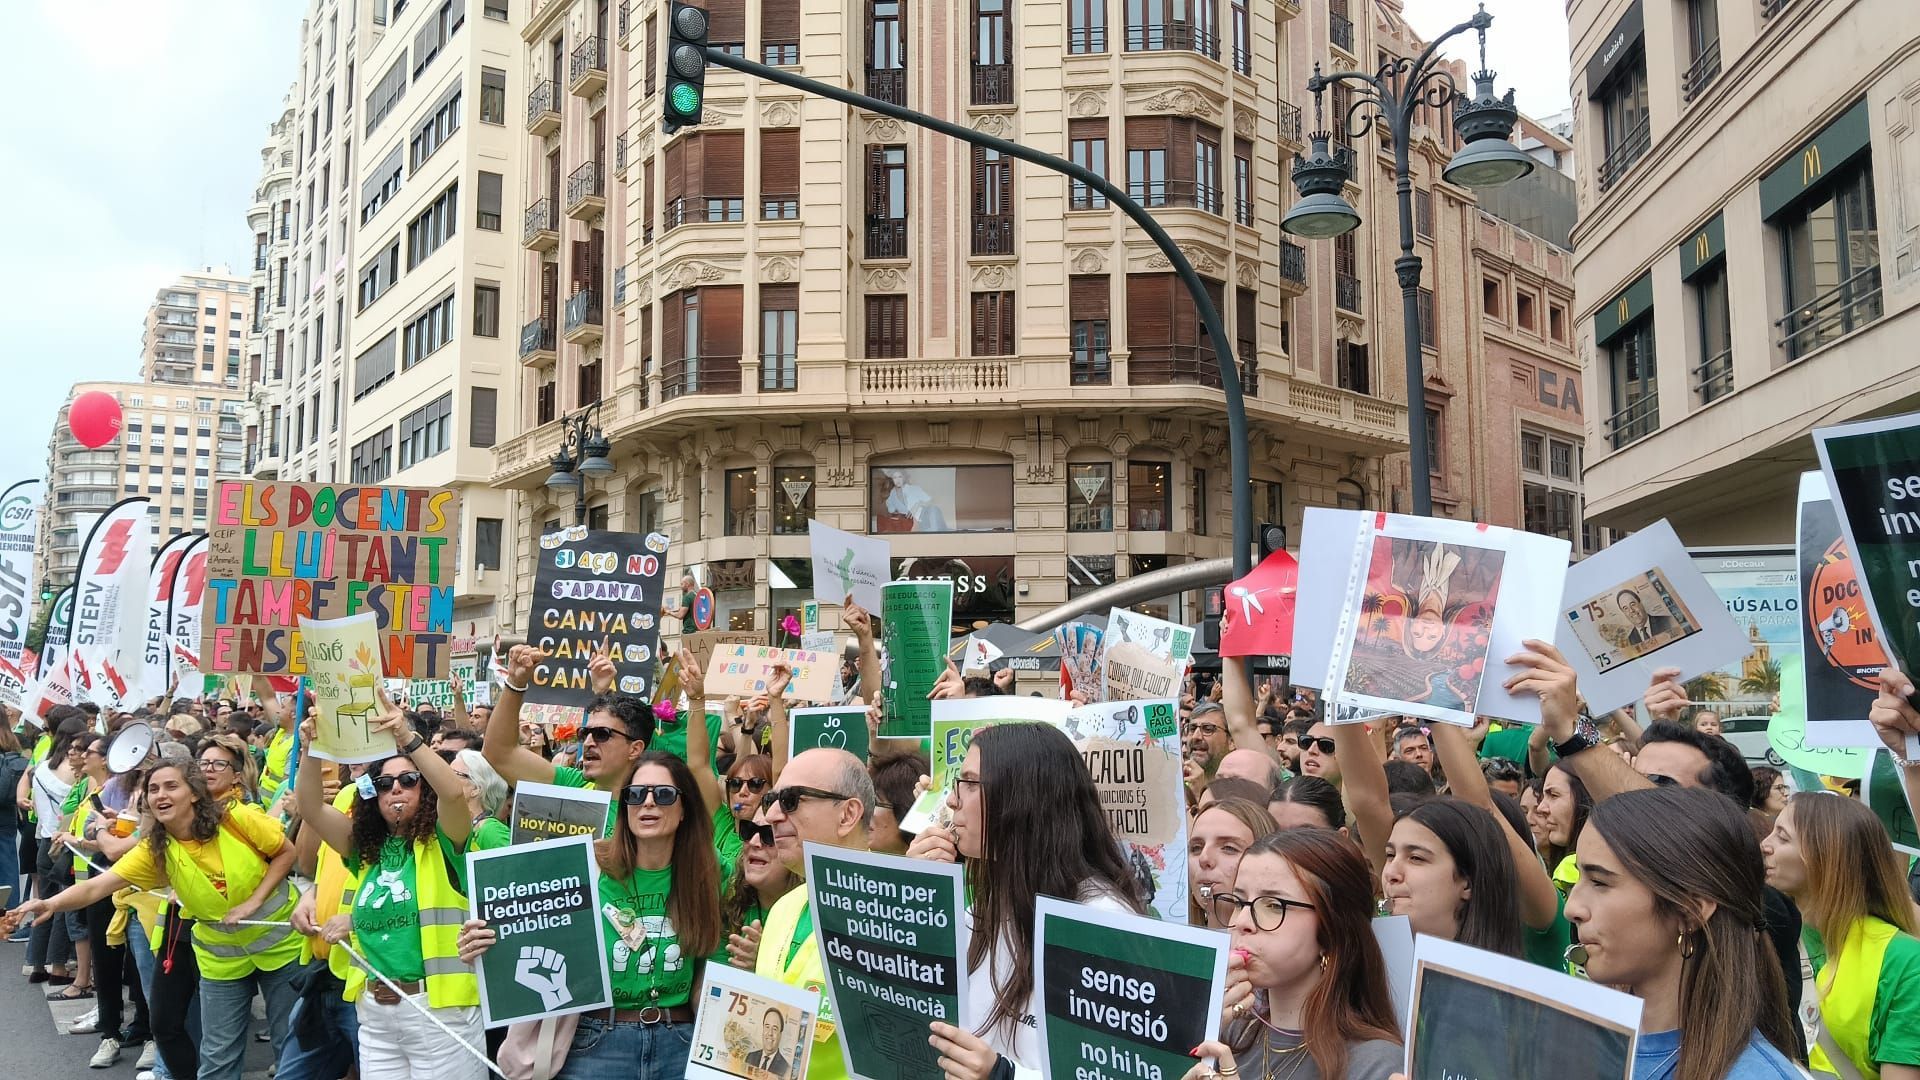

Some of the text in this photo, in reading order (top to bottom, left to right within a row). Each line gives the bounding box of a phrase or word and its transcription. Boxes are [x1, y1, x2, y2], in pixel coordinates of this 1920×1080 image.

[217, 483, 454, 532] ELS DOCENTS
[556, 550, 573, 566] SI
[628, 556, 657, 575] NO
[1720, 560, 1766, 568] JCDecaux
[553, 581, 642, 600] S'APANYA
[77, 581, 104, 645] STEPV
[209, 575, 455, 633] TAMBÉ ESTEM
[1581, 600, 1605, 622] 75
[543, 608, 628, 634] CANYA
[145, 607, 162, 665] STEPV
[689, 638, 709, 654] LA
[211, 628, 448, 679] ENSENT
[727, 645, 745, 657] LA
[1267, 656, 1292, 668] McD
[1595, 652, 1611, 668] 75
[533, 664, 617, 692] CAN
[719, 662, 749, 674] VEU
[744, 680, 795, 693] EDA
[823, 716, 841, 728] Jo
[1150, 716, 1172, 729] FAIG
[1151, 705, 1167, 718] JO
[1152, 727, 1174, 737] VAGA
[519, 817, 546, 831] HOY
[547, 822, 566, 833] NO
[483, 875, 581, 902] Defensem
[825, 868, 937, 904] Lluitem per
[484, 890, 583, 920] l'educació
[819, 890, 948, 928] una educació
[499, 913, 572, 940] pública
[846, 918, 917, 947] pública
[827, 936, 945, 986] de qualitat
[837, 968, 946, 1019] i en valencià
[1081, 966, 1156, 1004] sense
[728, 991, 749, 1016] 75
[1069, 988, 1168, 1042] inversió
[698, 1043, 714, 1061] 75
[1081, 1041, 1108, 1065] no
[1110, 1045, 1131, 1074] hi
